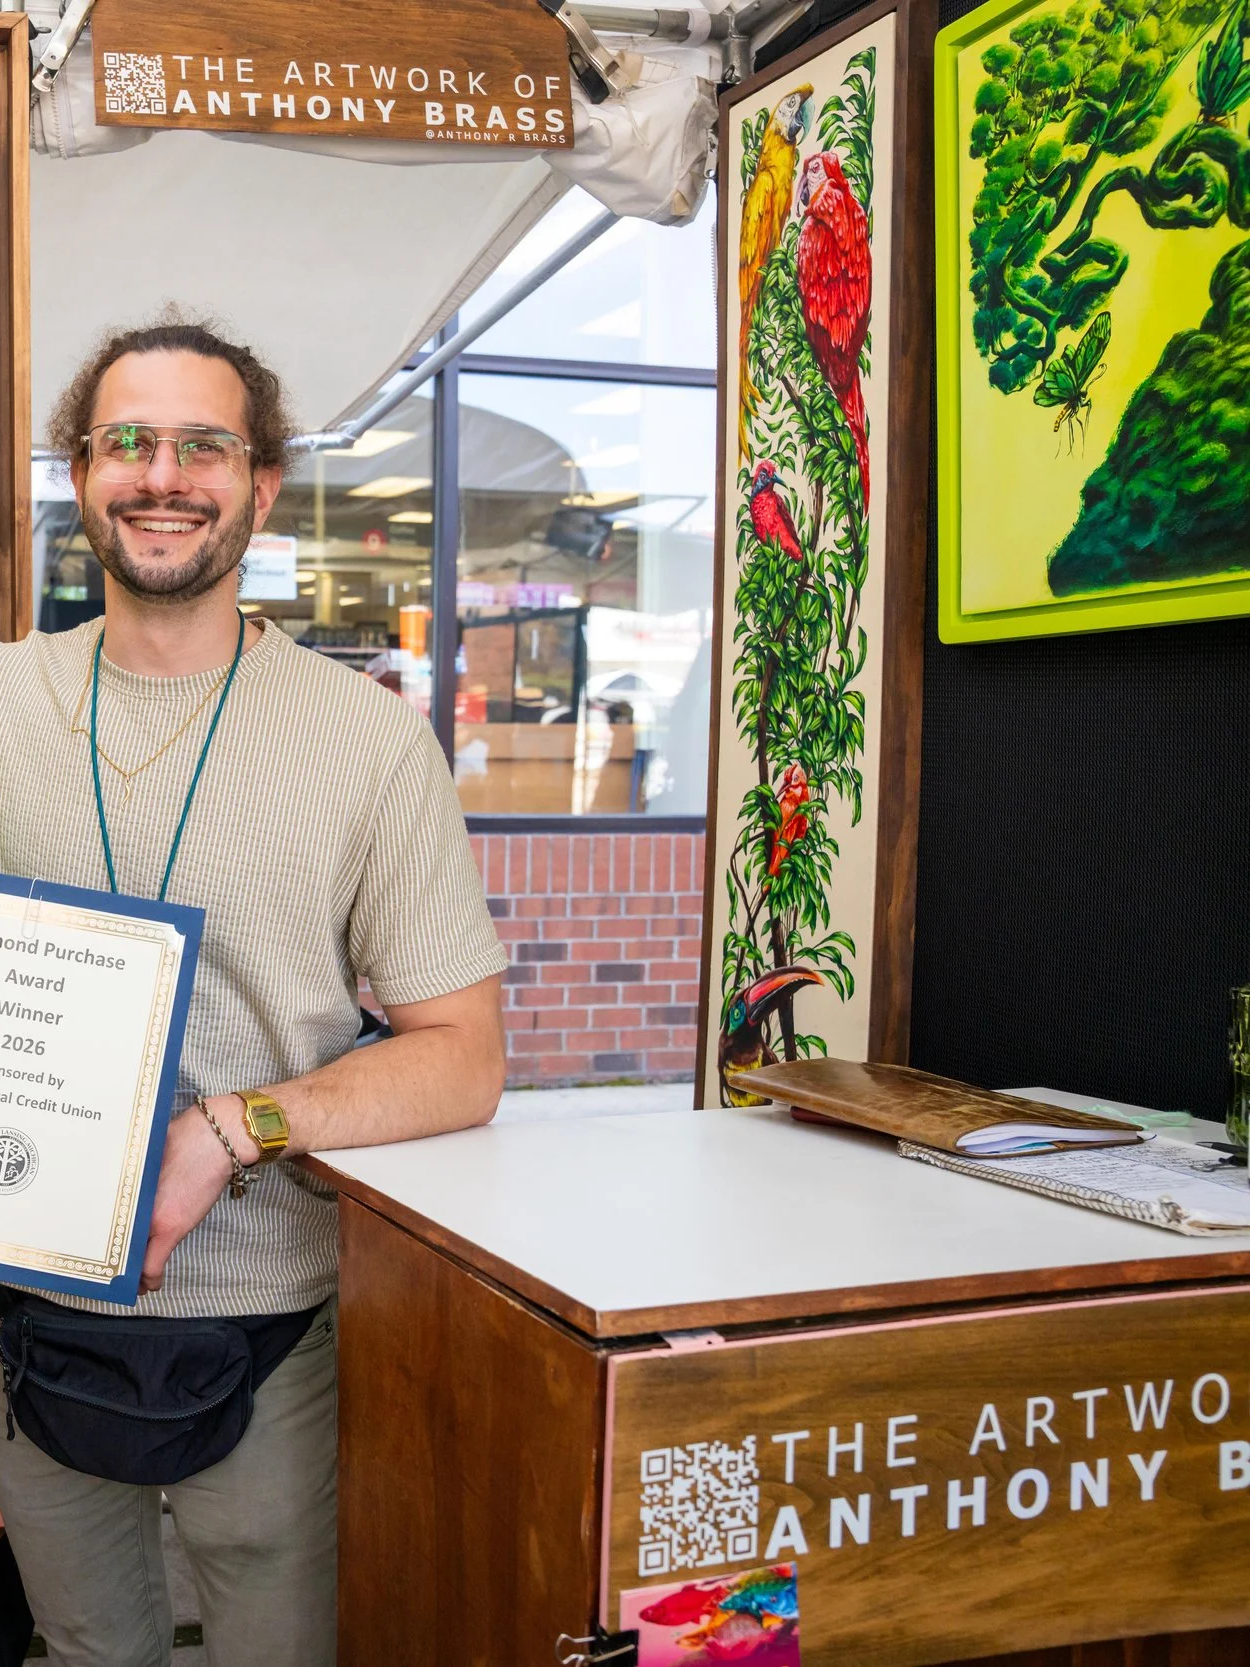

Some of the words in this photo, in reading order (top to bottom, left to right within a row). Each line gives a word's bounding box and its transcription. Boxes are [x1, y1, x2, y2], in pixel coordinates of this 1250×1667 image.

[172, 56, 254, 82] THE
[284, 61, 488, 95] ARTWORK
[515, 74, 561, 100] OF
[172, 90, 396, 124] ANTHONY
[426, 102, 565, 132] BRASS
[425, 130, 500, 142] @ANTHONY
[509, 133, 516, 142] R
[524, 134, 566, 144] BRASS
[44, 941, 126, 970] Purchase
[4, 968, 65, 992] Award
[1, 1034, 46, 1056] 2026
[48, 1072, 65, 1090] by
[16, 1094, 57, 1112] Credit
[61, 1103, 102, 1120] Union
[772, 1415, 918, 1484] THE
[969, 1372, 1250, 1455] ARTWO
[764, 1449, 1168, 1560] ANTHONY
